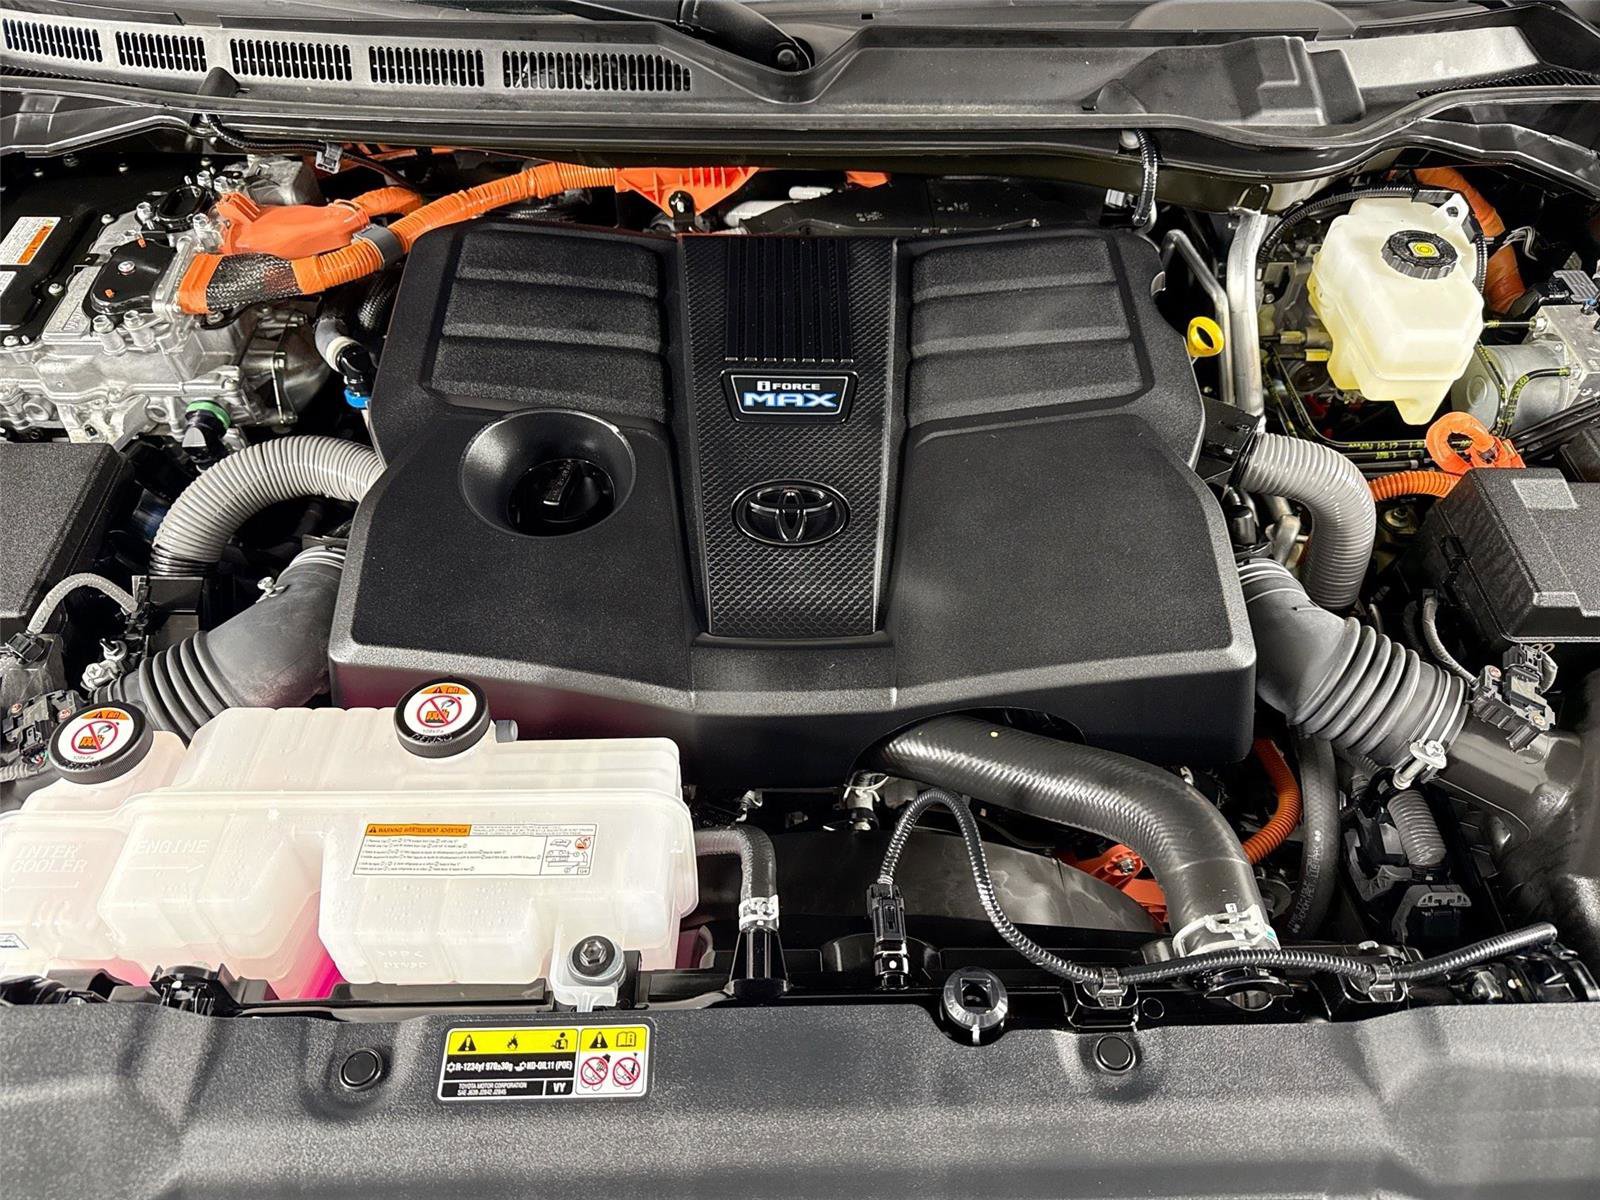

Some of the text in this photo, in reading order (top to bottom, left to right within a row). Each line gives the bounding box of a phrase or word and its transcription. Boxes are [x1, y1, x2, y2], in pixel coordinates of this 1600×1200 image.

[743, 392, 837, 408] MAX
[16, 844, 80, 860] INTER
[134, 839, 210, 855] ENGINE
[11, 859, 88, 873] COOLER
[552, 1082, 567, 1093] VY
